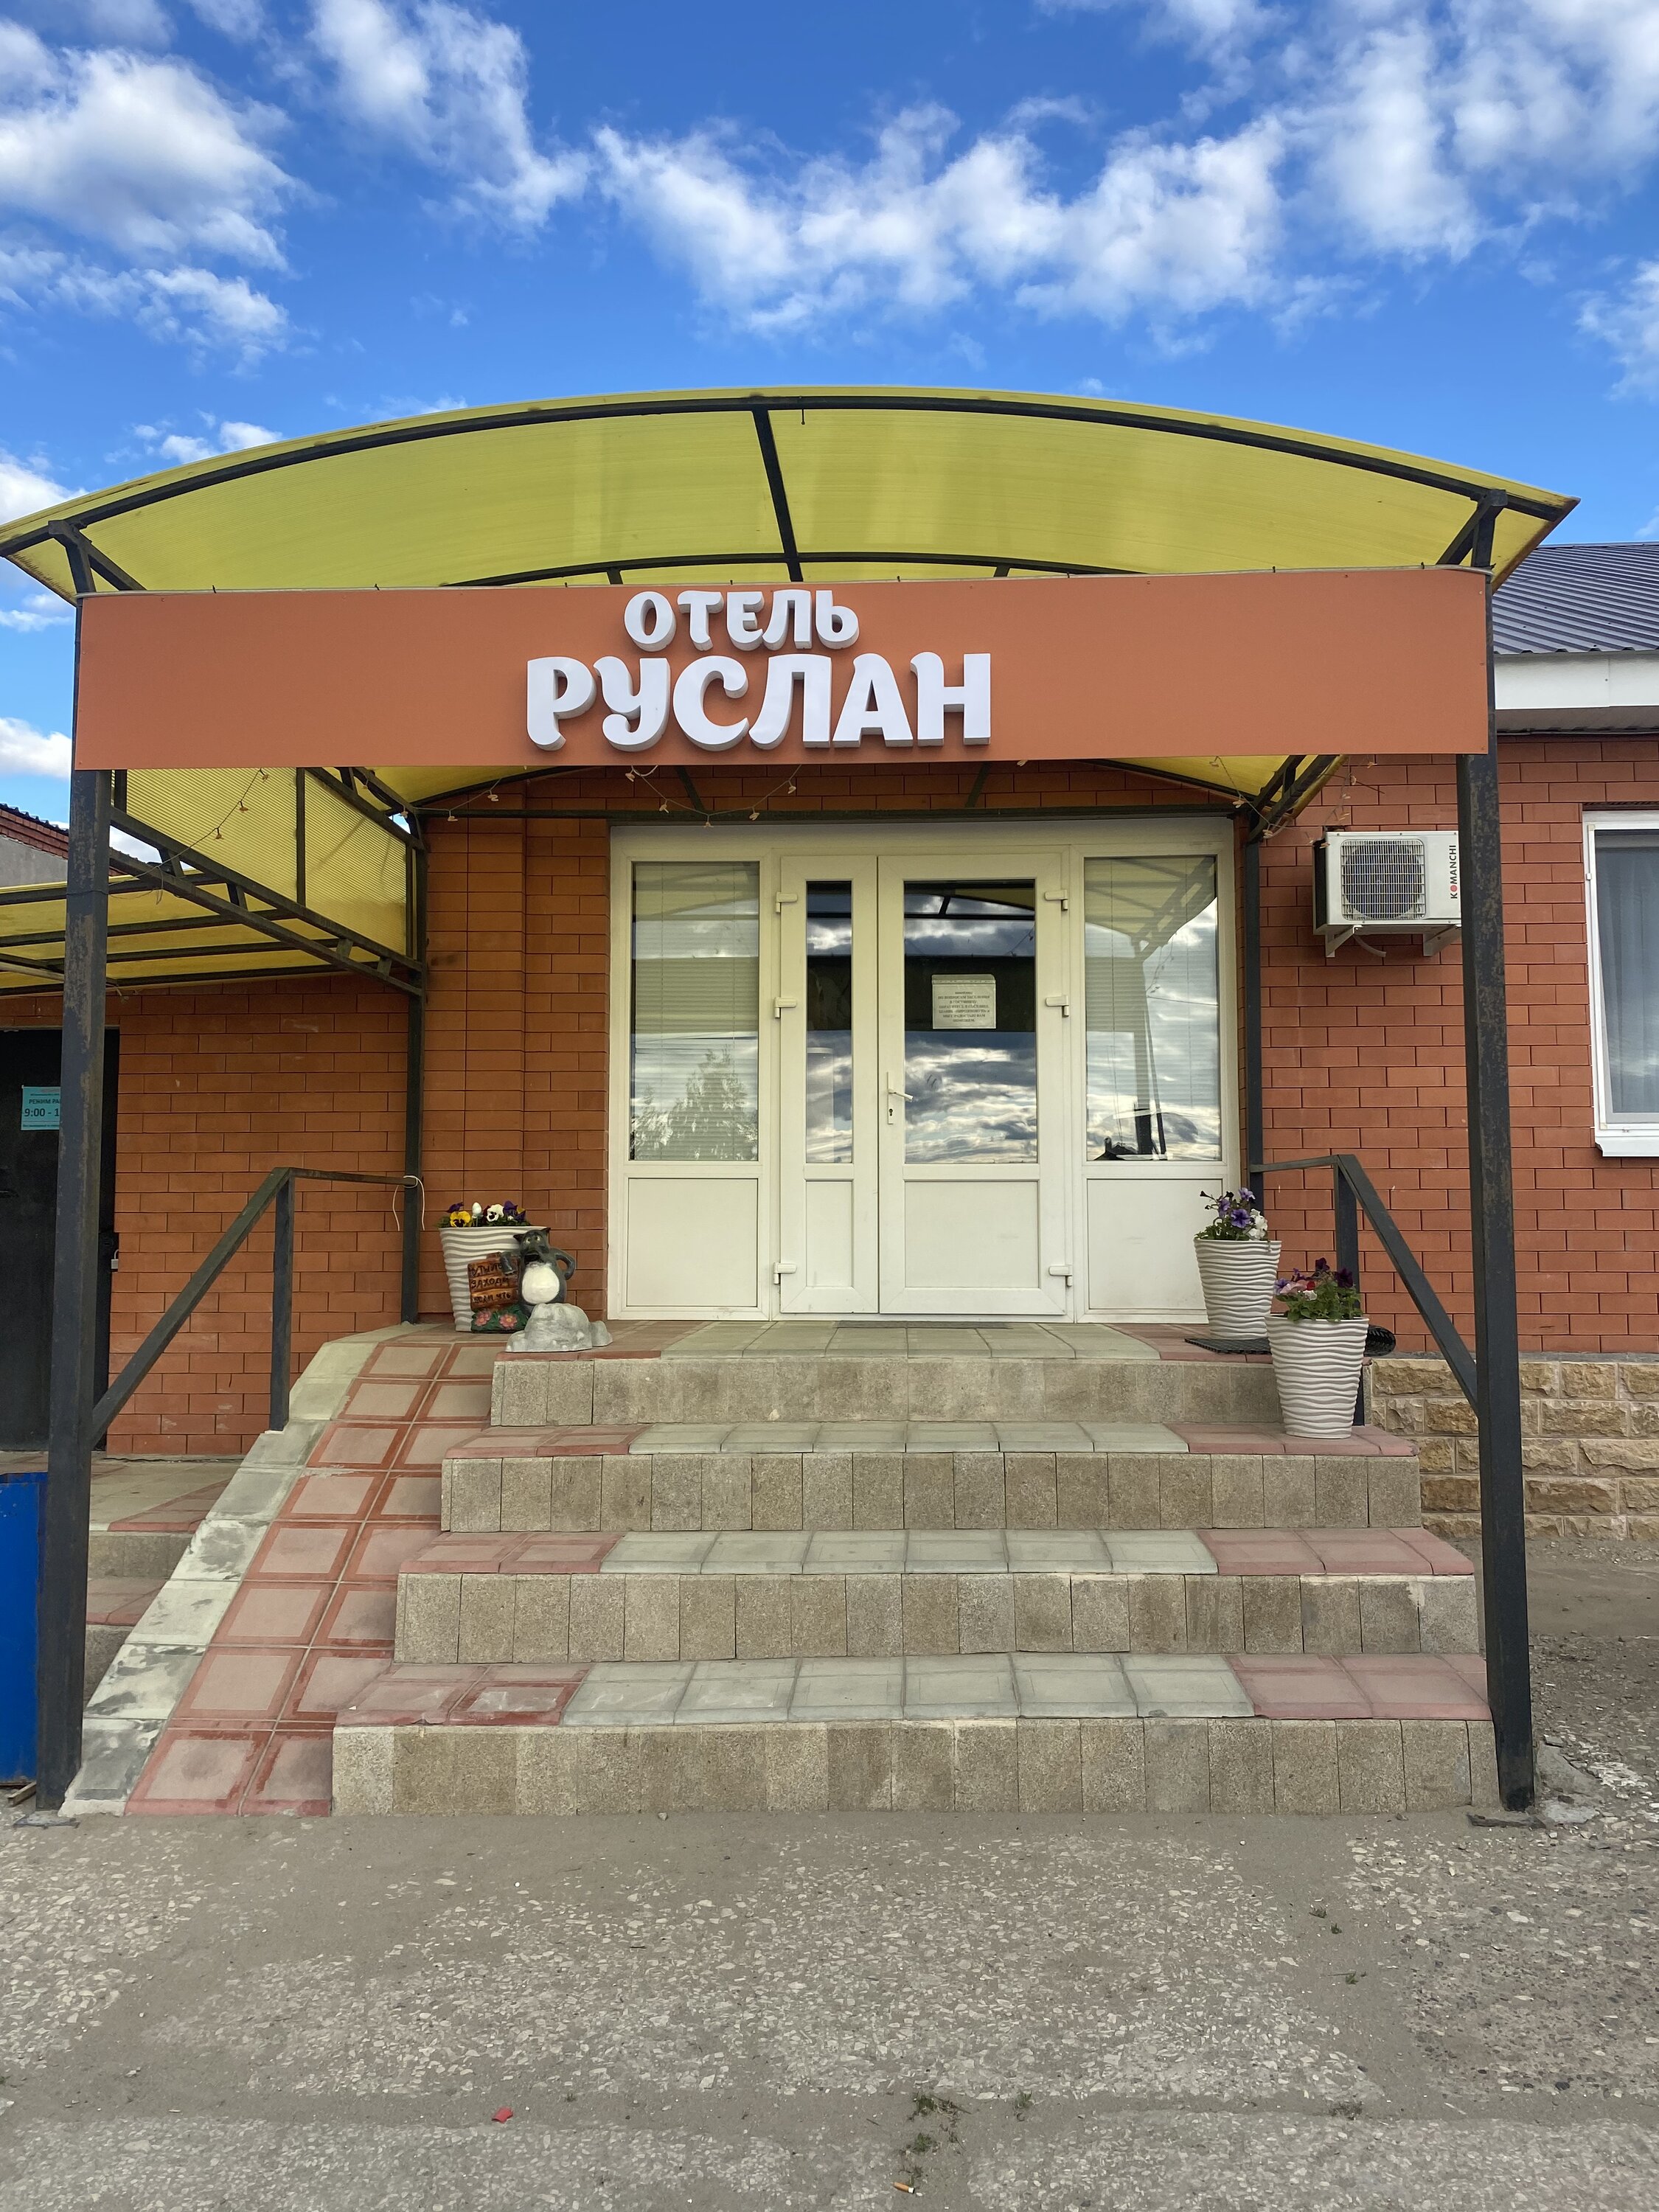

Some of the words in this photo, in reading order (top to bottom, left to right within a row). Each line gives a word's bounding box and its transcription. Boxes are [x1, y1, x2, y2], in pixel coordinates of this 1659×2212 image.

[624, 589, 860, 652] ОТЕЛЬ
[526, 651, 991, 752] РУСЛАН
[1449, 845, 1458, 899] KOMANCHI
[24, 1108, 46, 1117] 9:00
